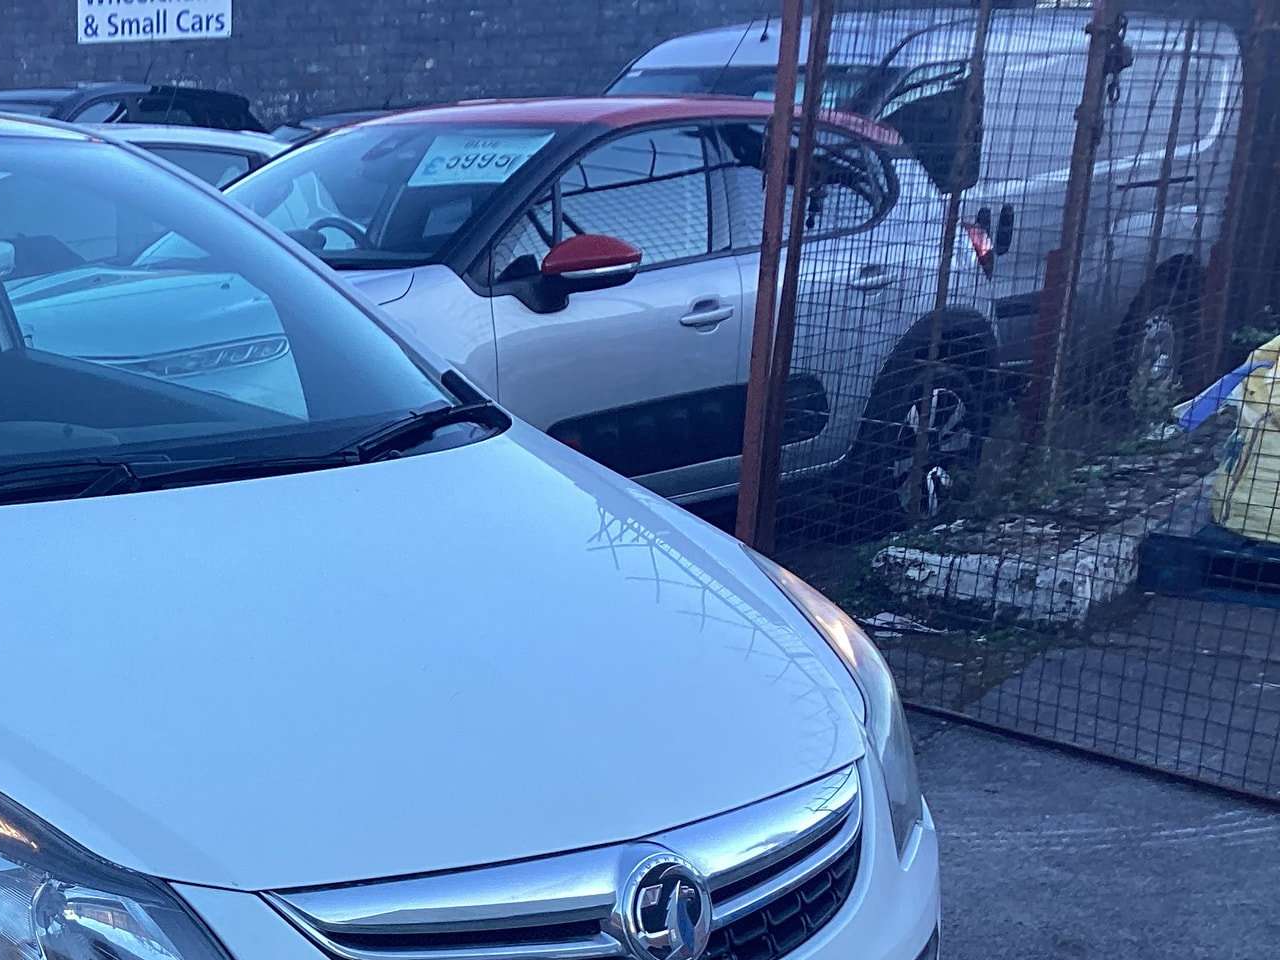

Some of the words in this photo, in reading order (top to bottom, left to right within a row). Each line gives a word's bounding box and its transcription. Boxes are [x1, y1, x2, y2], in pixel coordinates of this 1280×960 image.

[83, 14, 99, 37] &
[107, 9, 167, 36] Small
[176, 9, 225, 32] Cars
